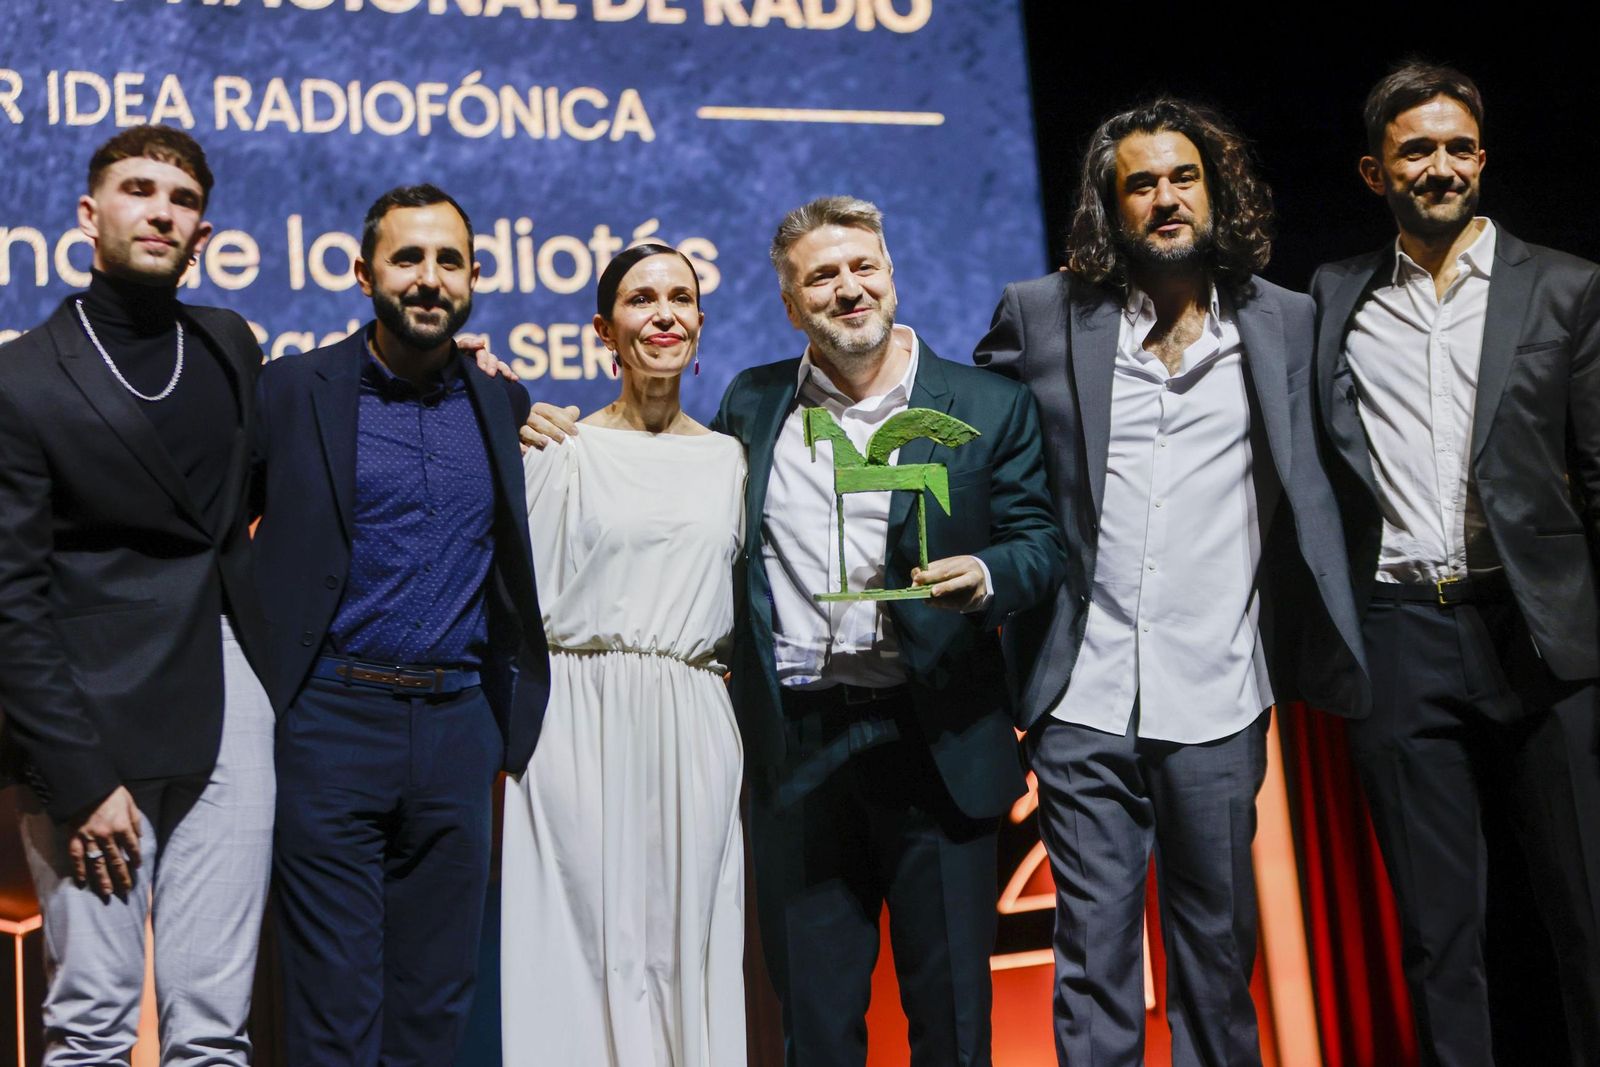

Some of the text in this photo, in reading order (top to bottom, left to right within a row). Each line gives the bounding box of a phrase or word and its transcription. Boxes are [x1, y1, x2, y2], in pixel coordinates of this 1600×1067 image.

[47, 70, 196, 130] IDEA
[213, 70, 656, 142] RADIOFÓNICA
[473, 217, 721, 294] diots
[508, 322, 622, 381] SER
